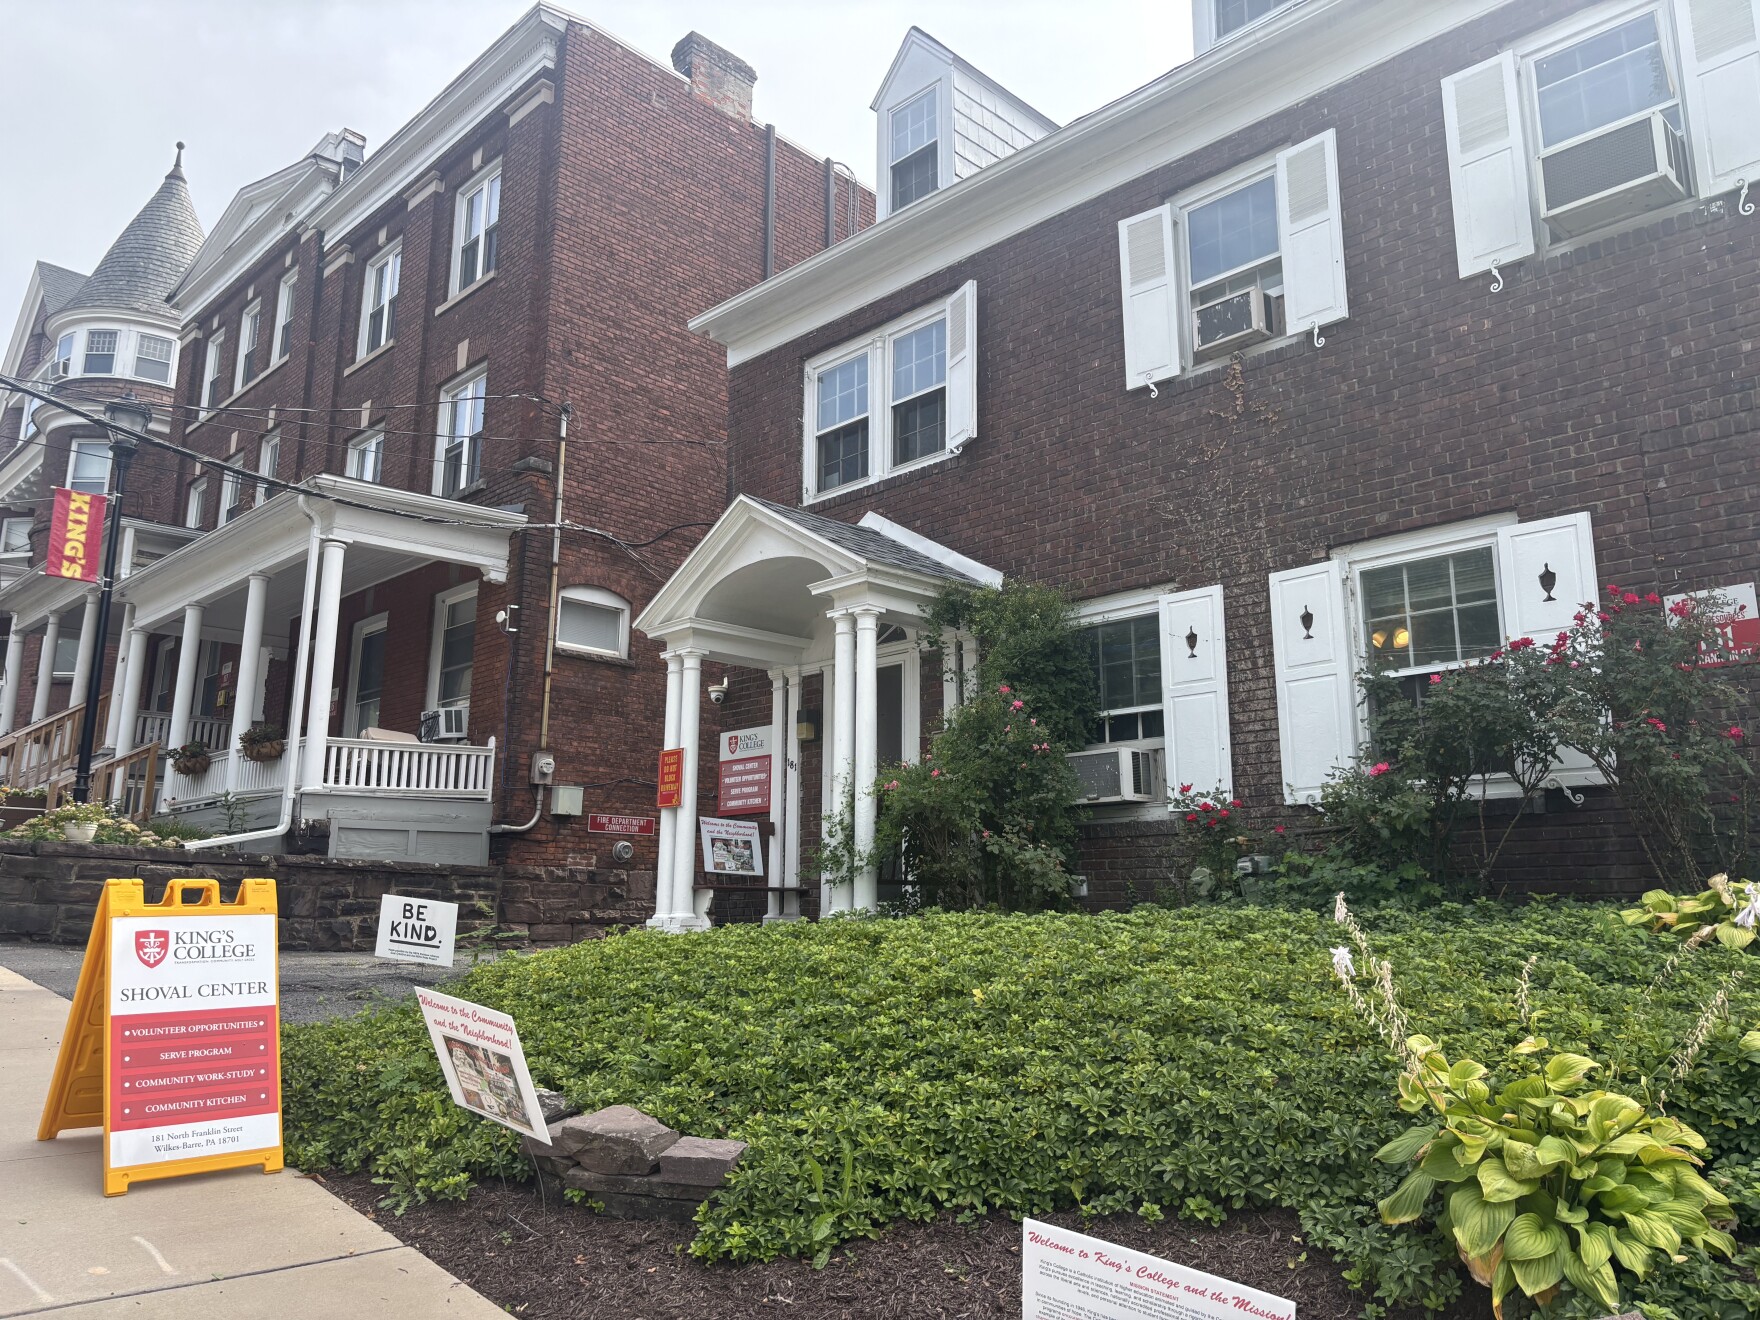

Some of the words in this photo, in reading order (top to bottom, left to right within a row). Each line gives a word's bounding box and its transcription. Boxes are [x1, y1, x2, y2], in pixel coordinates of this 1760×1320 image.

[61, 490, 92, 579] KING'S
[739, 740, 764, 750] COLLEGE
[740, 733, 758, 742] KING'S
[788, 758, 797, 772] 181
[605, 824, 639, 832] CONNECTION
[612, 817, 647, 826] DEPARTMENT
[403, 903, 428, 921] BE
[175, 930, 234, 945] KING'S
[390, 921, 442, 944] KIND.
[174, 944, 256, 960] COLLEGE
[120, 985, 192, 1001] SHOVAL
[198, 981, 269, 997] CENTER
[418, 994, 450, 1013] Welcome
[451, 1004, 459, 1015] to
[459, 1007, 470, 1019] the
[472, 1009, 513, 1035] Community
[132, 1025, 186, 1037] VOLUNTEER
[188, 1021, 258, 1033] OPPORTUNITIES
[433, 1018, 447, 1029] and
[448, 1020, 459, 1032] the
[461, 1023, 512, 1050] Neighborhood!
[160, 1051, 187, 1060] SERVE
[188, 1047, 232, 1058] PROGRAM
[136, 1076, 195, 1088] COMMUNITY
[197, 1069, 255, 1081] WORK-STUDY
[145, 1100, 205, 1113] COMMUNITY
[206, 1095, 247, 1107] KITCHEN
[151, 1134, 164, 1143] 181
[167, 1131, 190, 1141] North
[192, 1129, 221, 1138] Franklin
[223, 1125, 243, 1134] Street
[154, 1141, 204, 1153] Wilkes-Barre,
[218, 1135, 240, 1145] 18701
[1028, 1231, 1075, 1255] Welcome
[1078, 1249, 1089, 1259] to
[1094, 1251, 1132, 1273] King's
[1136, 1265, 1180, 1290] College
[1184, 1285, 1208, 1298] and
[1210, 1292, 1229, 1305] the
[1150, 1288, 1179, 1302] STATEMENT
